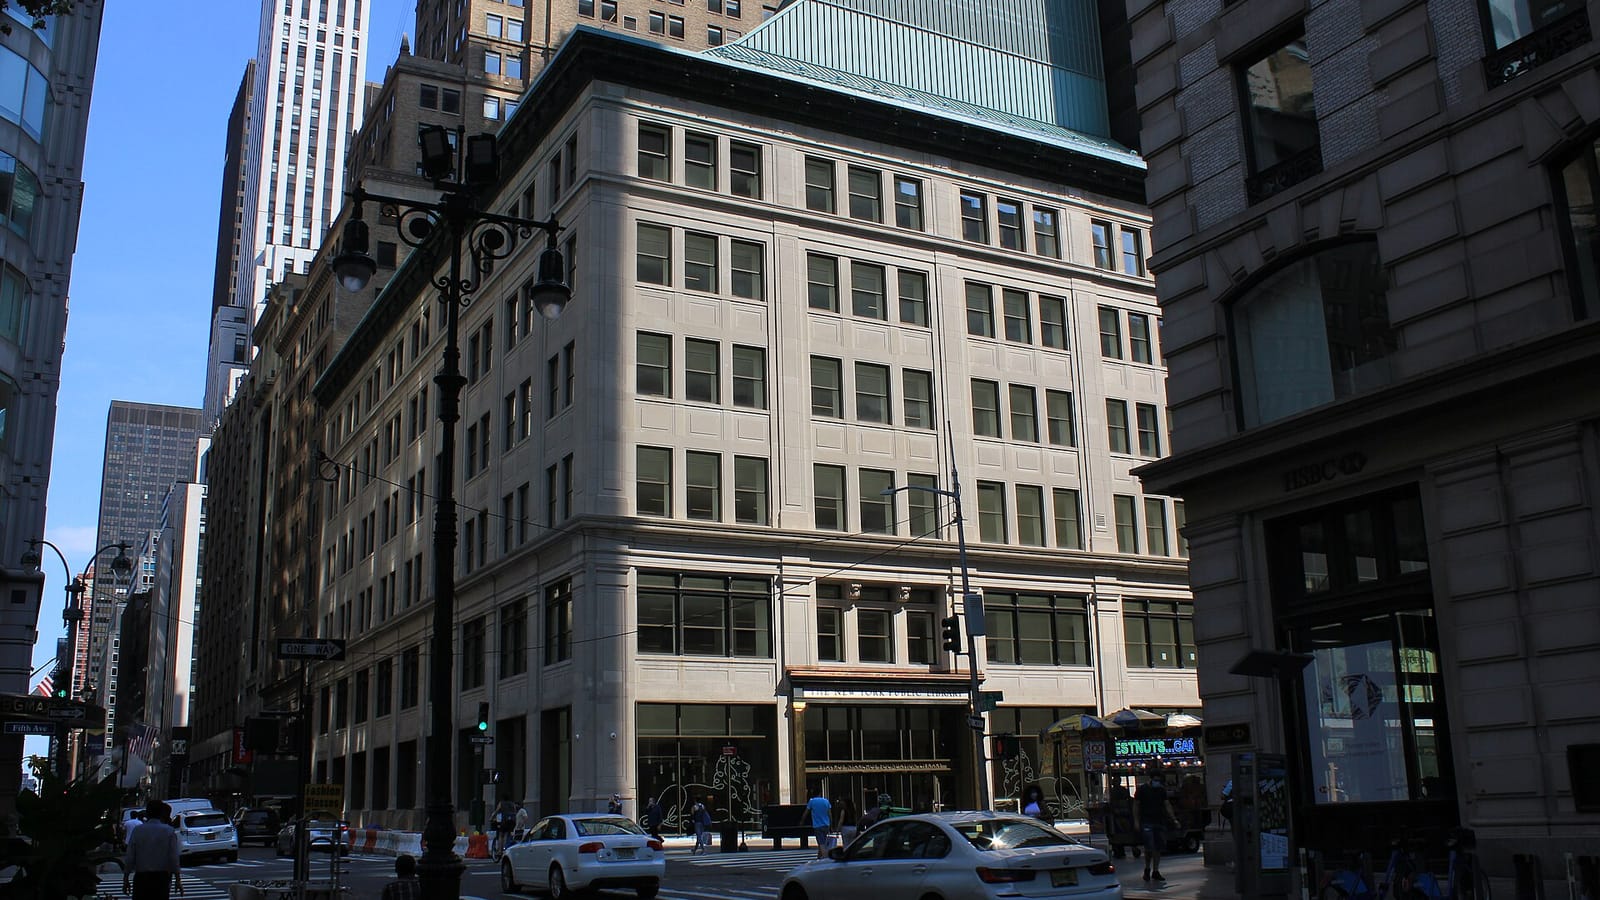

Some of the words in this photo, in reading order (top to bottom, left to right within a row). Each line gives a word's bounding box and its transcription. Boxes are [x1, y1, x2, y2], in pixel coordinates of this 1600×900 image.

[1283, 459, 1335, 491] HSBC
[286, 644, 305, 654] ONE
[315, 644, 336, 654] WAY
[835, 687, 855, 696] NEW
[888, 688, 922, 697] PUBLIC
[926, 688, 963, 698] LIBRARY
[12, 724, 31, 733] Fifth
[33, 724, 48, 733] Ave
